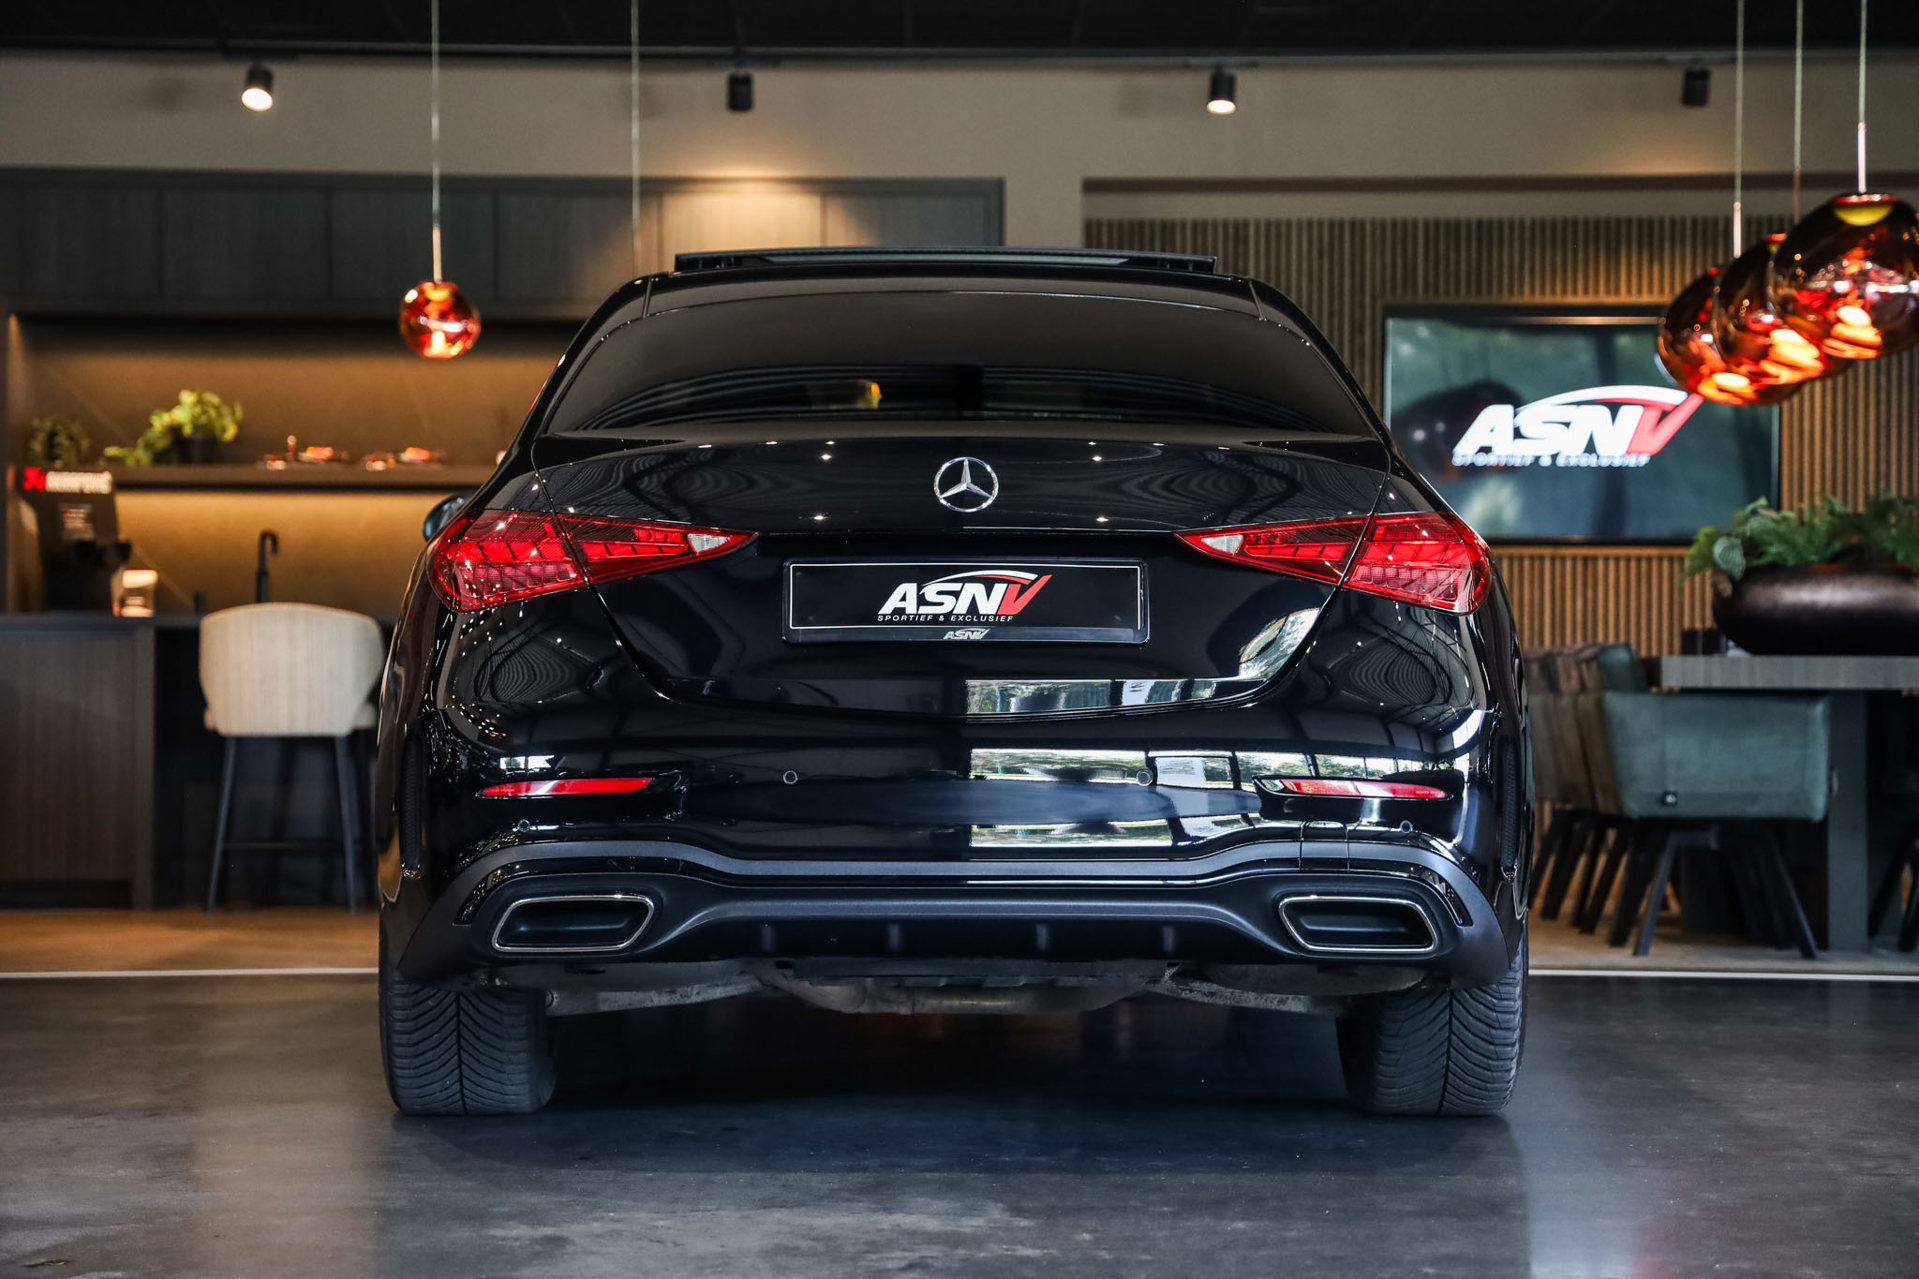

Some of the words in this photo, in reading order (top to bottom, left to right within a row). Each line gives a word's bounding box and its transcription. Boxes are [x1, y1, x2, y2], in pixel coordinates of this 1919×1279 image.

[1453, 386, 1703, 456] ASNV
[877, 571, 1053, 615] ASNV
[877, 614, 934, 622] SPORTIEF
[939, 614, 945, 622] &
[950, 614, 1013, 622] EXCLUSIEF
